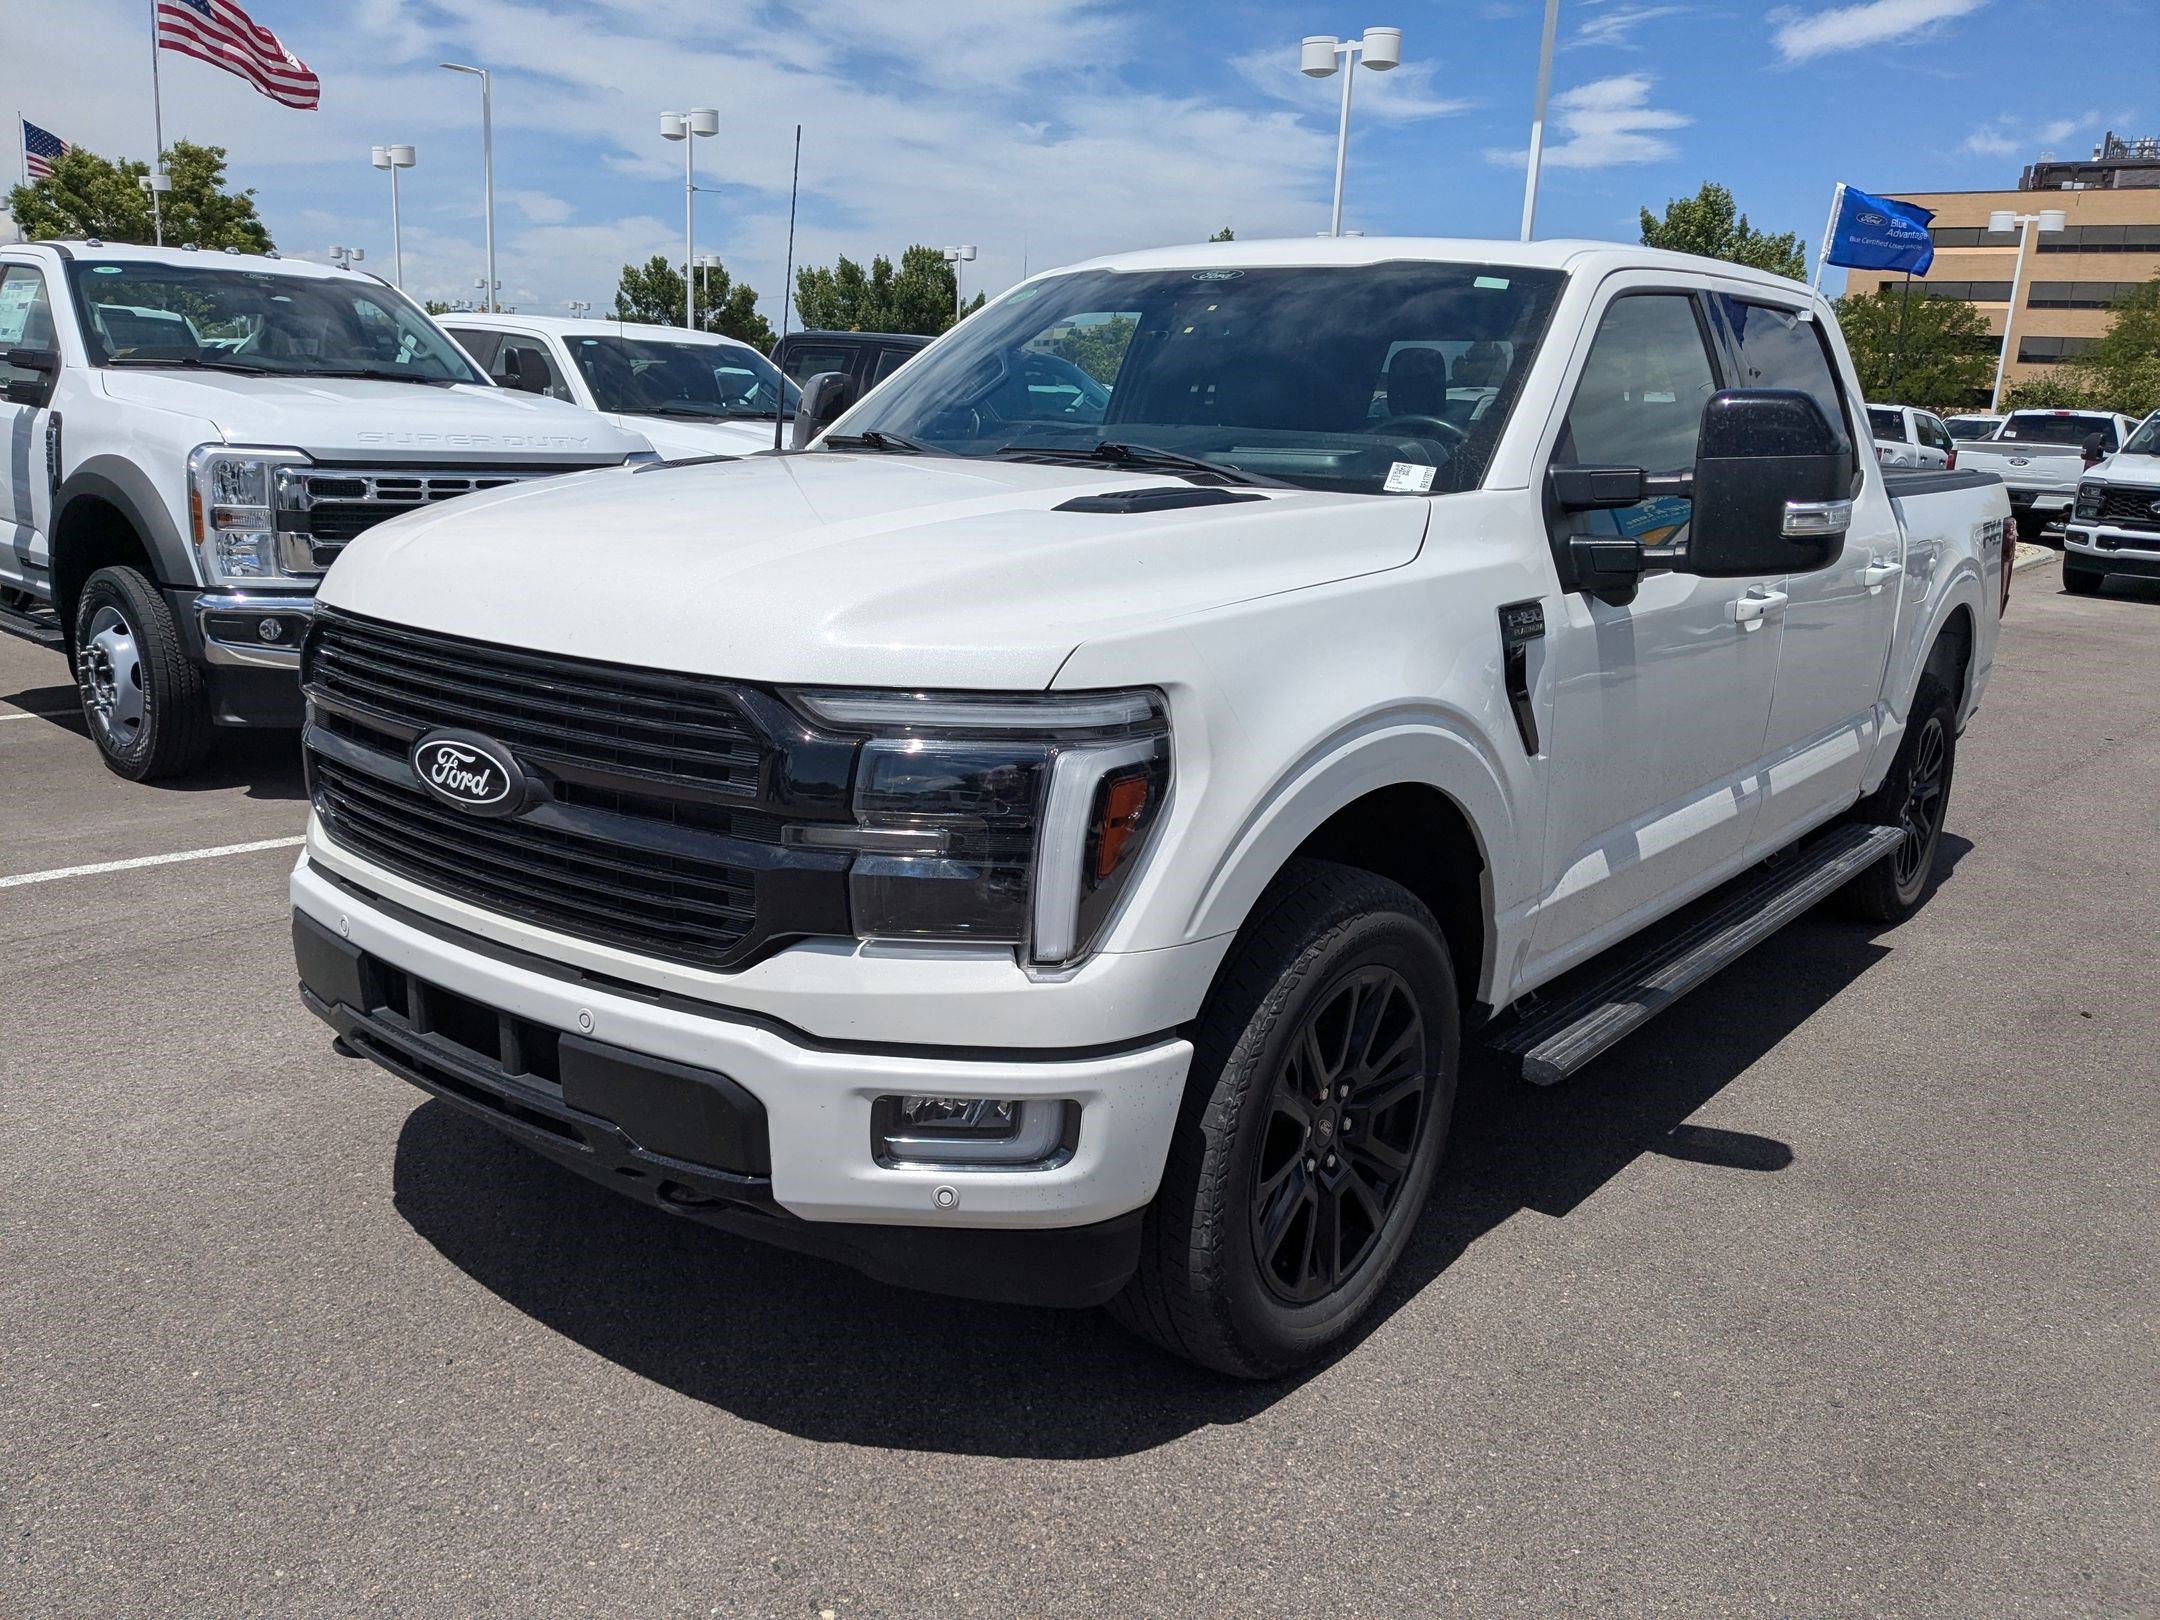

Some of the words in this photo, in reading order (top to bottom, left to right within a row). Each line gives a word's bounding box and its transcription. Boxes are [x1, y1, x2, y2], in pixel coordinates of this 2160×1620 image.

[1890, 219, 1908, 229] Blue
[1886, 228, 1928, 240] Advantage
[357, 431, 497, 449] SUPER
[502, 435, 590, 450] DUTY
[431, 747, 491, 797] Ford
